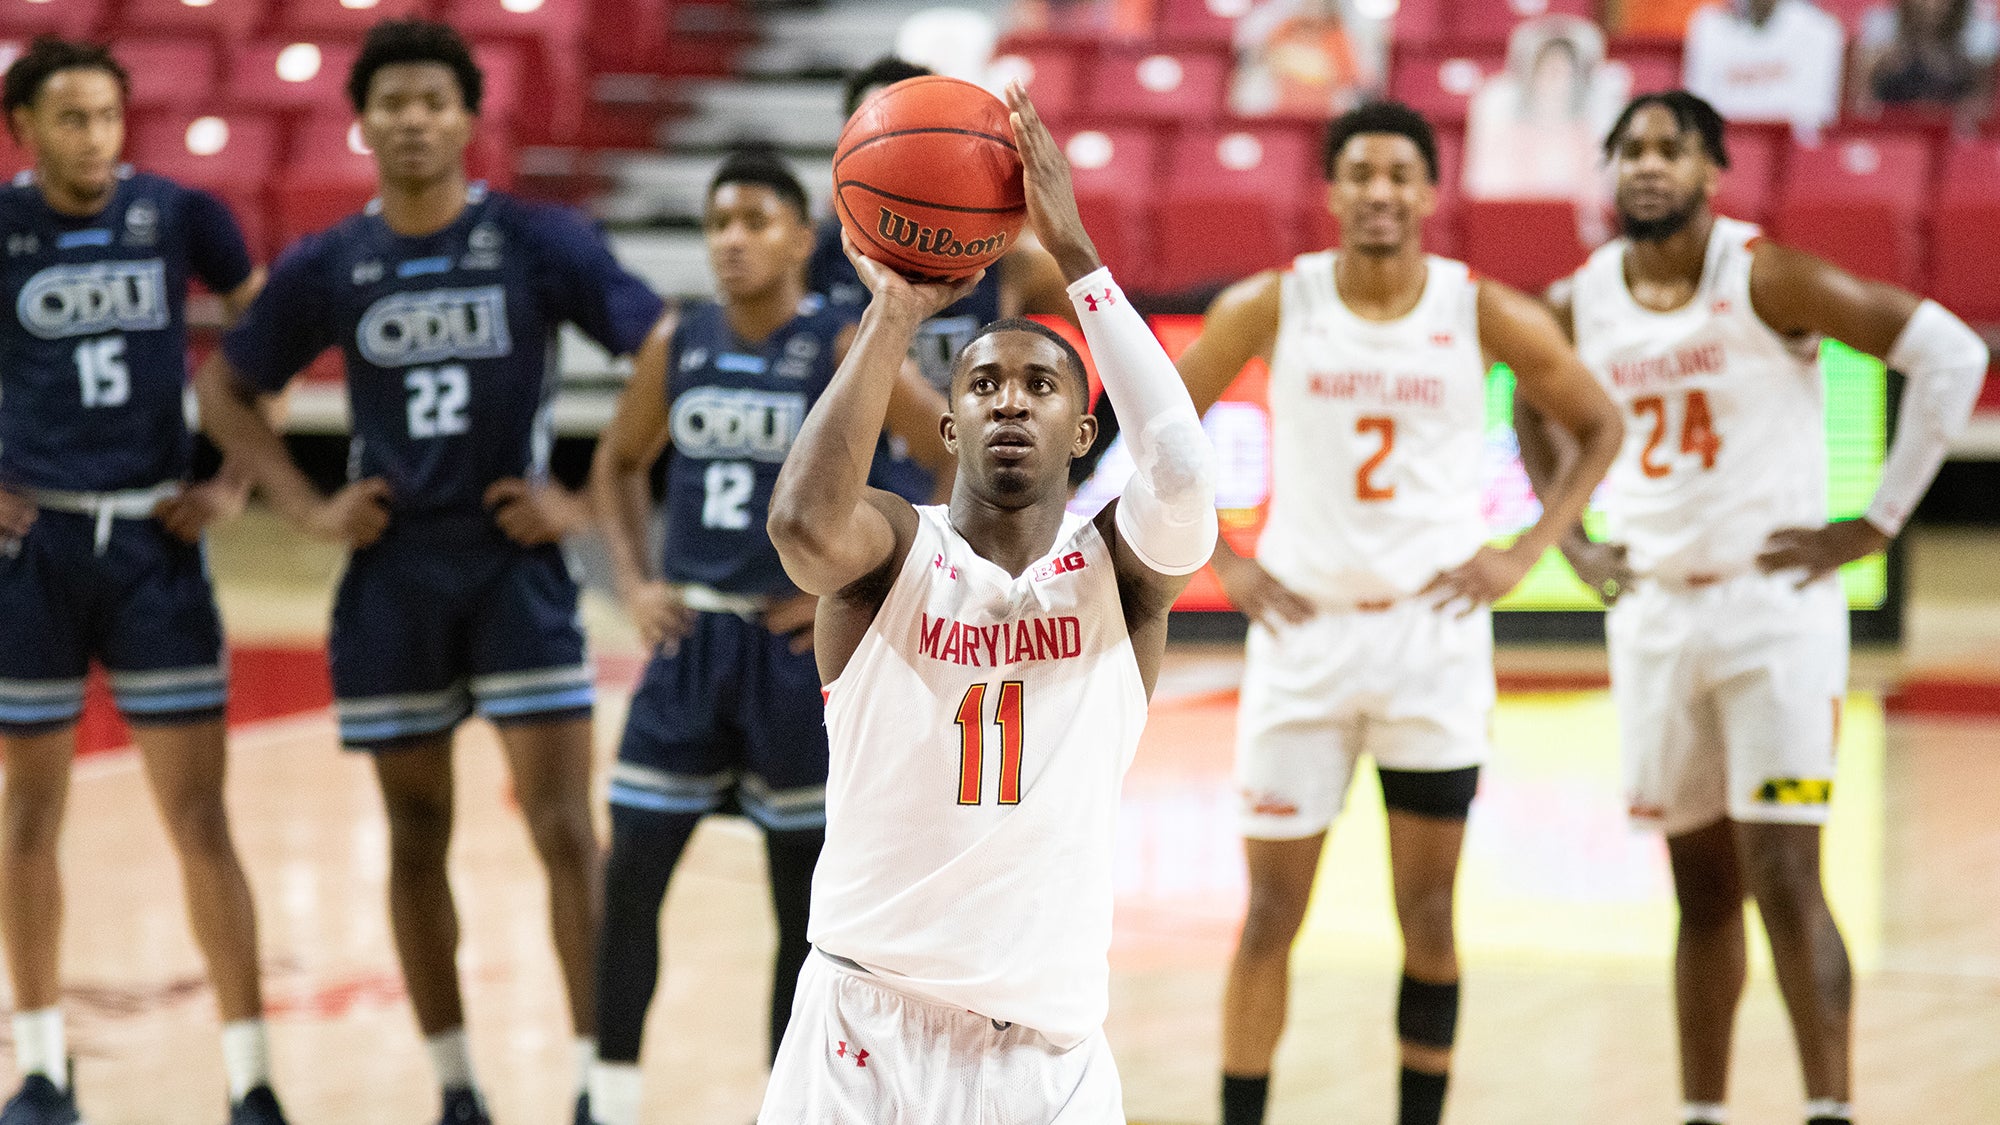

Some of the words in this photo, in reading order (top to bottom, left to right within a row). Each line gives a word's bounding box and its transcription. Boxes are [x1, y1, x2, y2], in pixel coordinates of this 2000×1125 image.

[876, 206, 1006, 258] Wilson
[18, 261, 167, 338] ODU
[358, 287, 509, 365] ODU
[73, 337, 130, 408] 15
[404, 364, 471, 440] 22
[670, 387, 806, 461] ODU
[1355, 415, 1396, 502] 2
[1632, 388, 1723, 479] 24
[703, 461, 756, 529] 12
[918, 612, 1082, 668] MARYLAND
[954, 680, 1024, 806] 11
